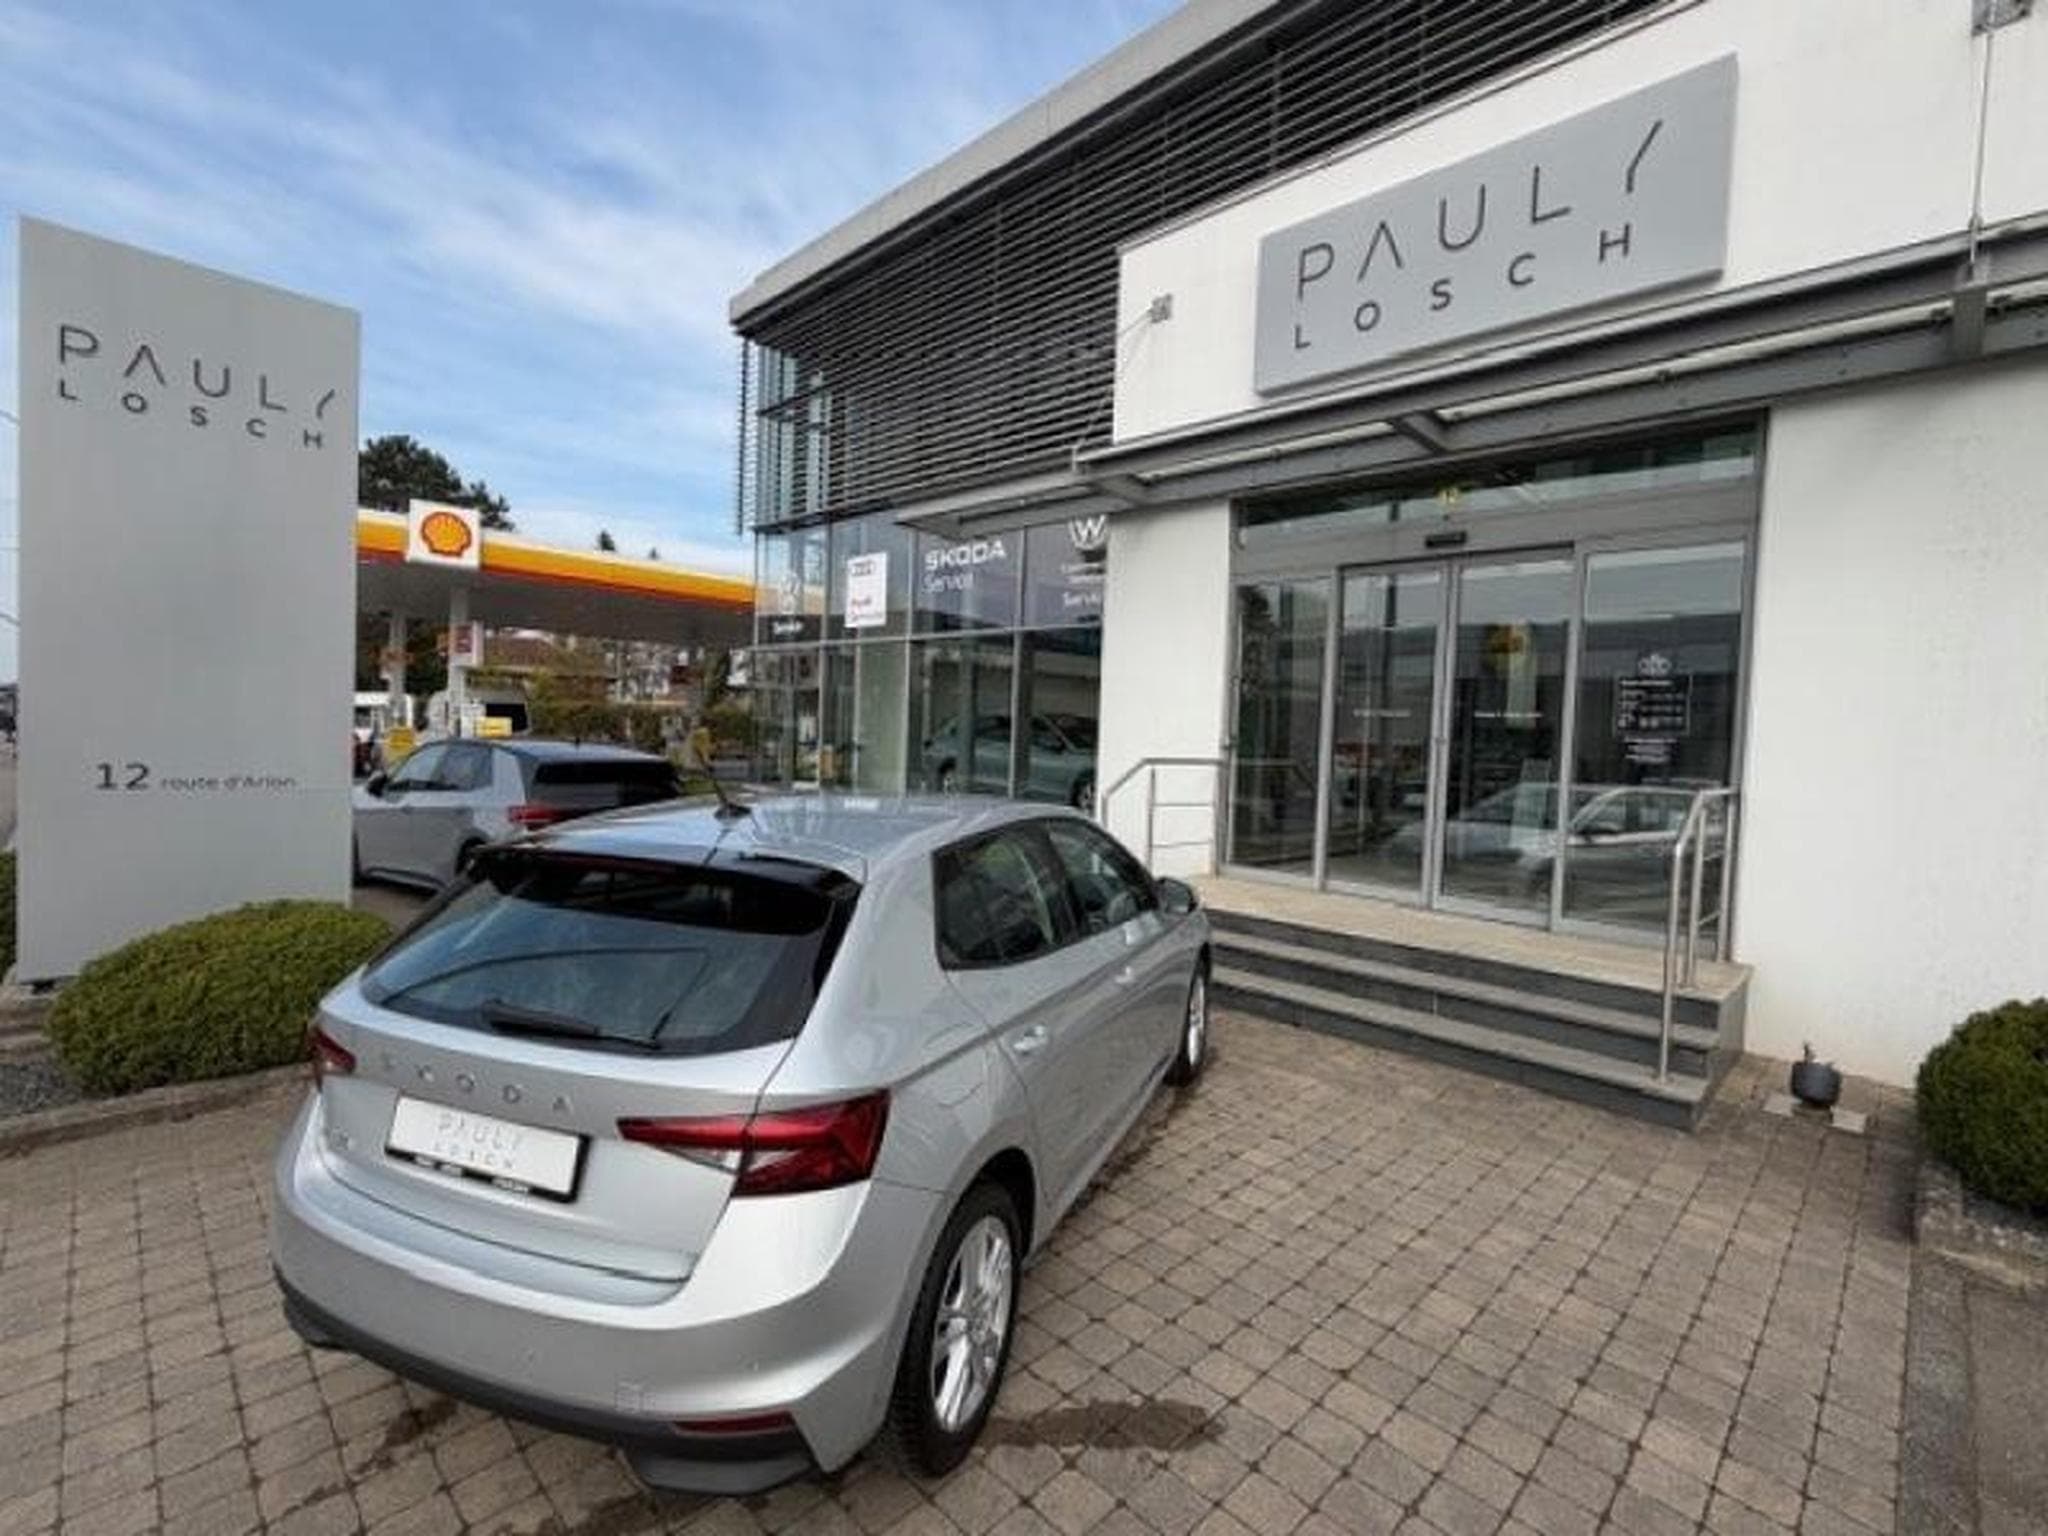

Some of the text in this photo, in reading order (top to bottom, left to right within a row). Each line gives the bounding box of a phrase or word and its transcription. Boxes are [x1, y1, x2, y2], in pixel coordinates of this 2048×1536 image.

[1295, 223, 1631, 349] LOSCH
[60, 379, 323, 449] LOSCH
[97, 763, 150, 791] 12
